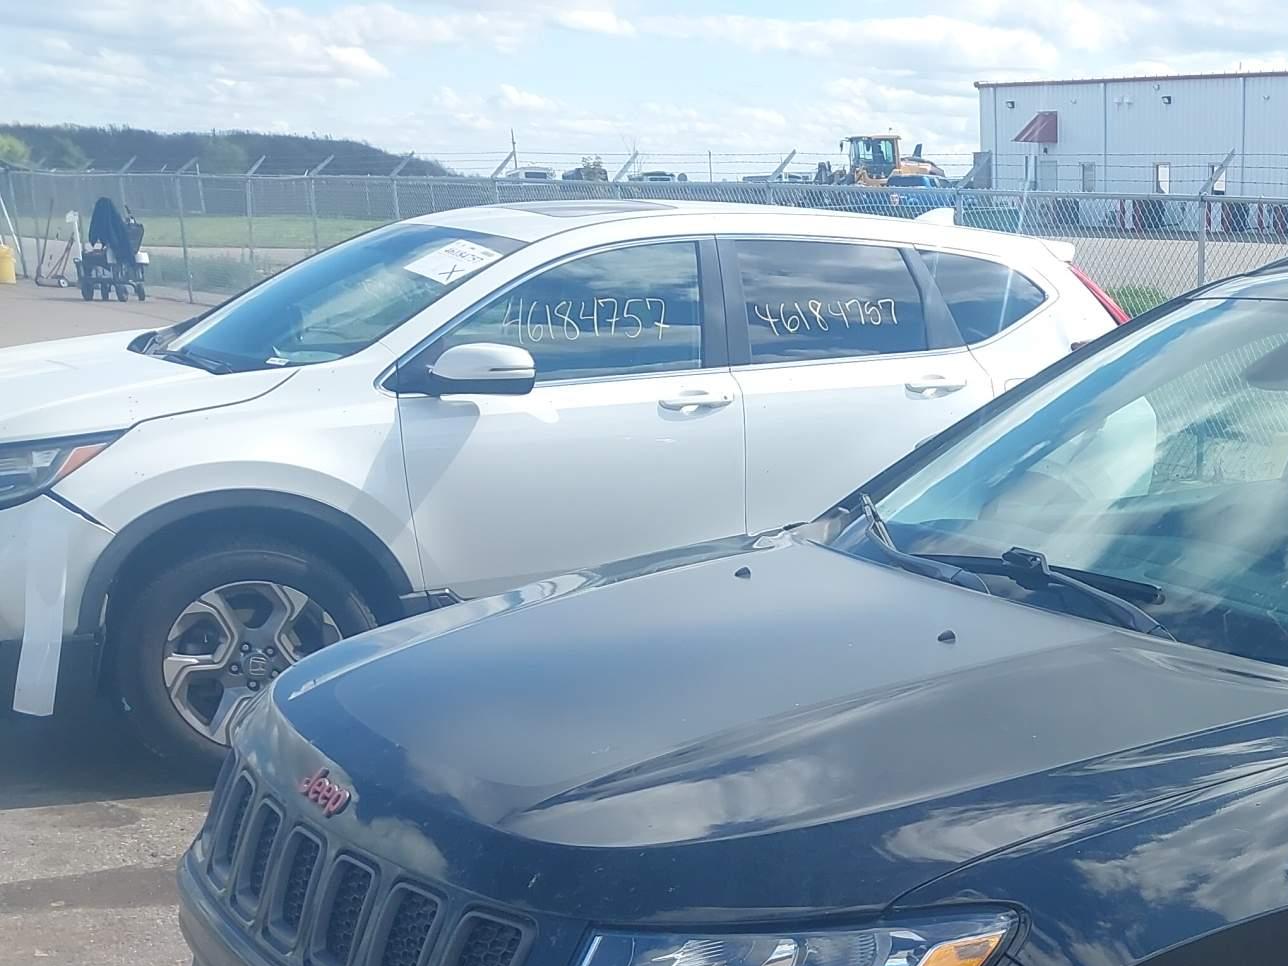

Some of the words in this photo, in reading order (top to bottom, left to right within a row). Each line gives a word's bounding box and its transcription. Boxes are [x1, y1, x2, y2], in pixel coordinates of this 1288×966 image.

[502, 296, 671, 344] 46184757
[754, 298, 898, 336] 46184757
[299, 767, 351, 818] Jeep
